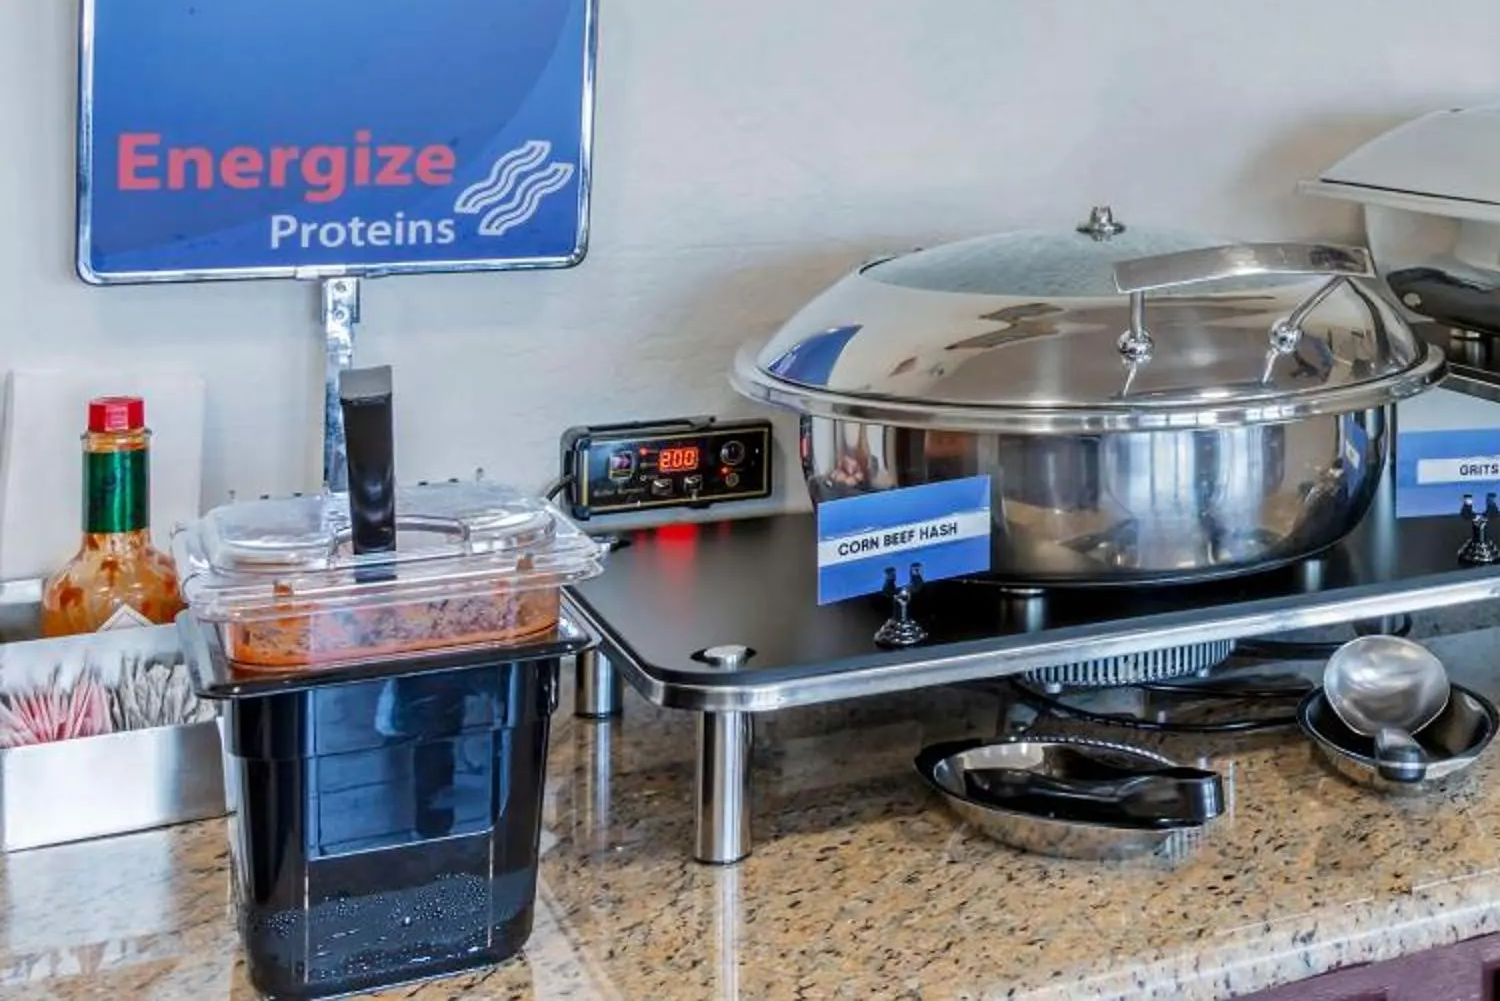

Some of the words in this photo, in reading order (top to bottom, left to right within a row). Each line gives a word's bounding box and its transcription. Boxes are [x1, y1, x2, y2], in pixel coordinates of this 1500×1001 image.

[117, 130, 456, 204] Energize
[270, 212, 456, 249] Proteins
[660, 449, 697, 469] 200
[1459, 463, 1500, 477] GRITS
[837, 536, 880, 557] CORN
[883, 529, 915, 548] BEEF
[919, 522, 958, 542] HASH
